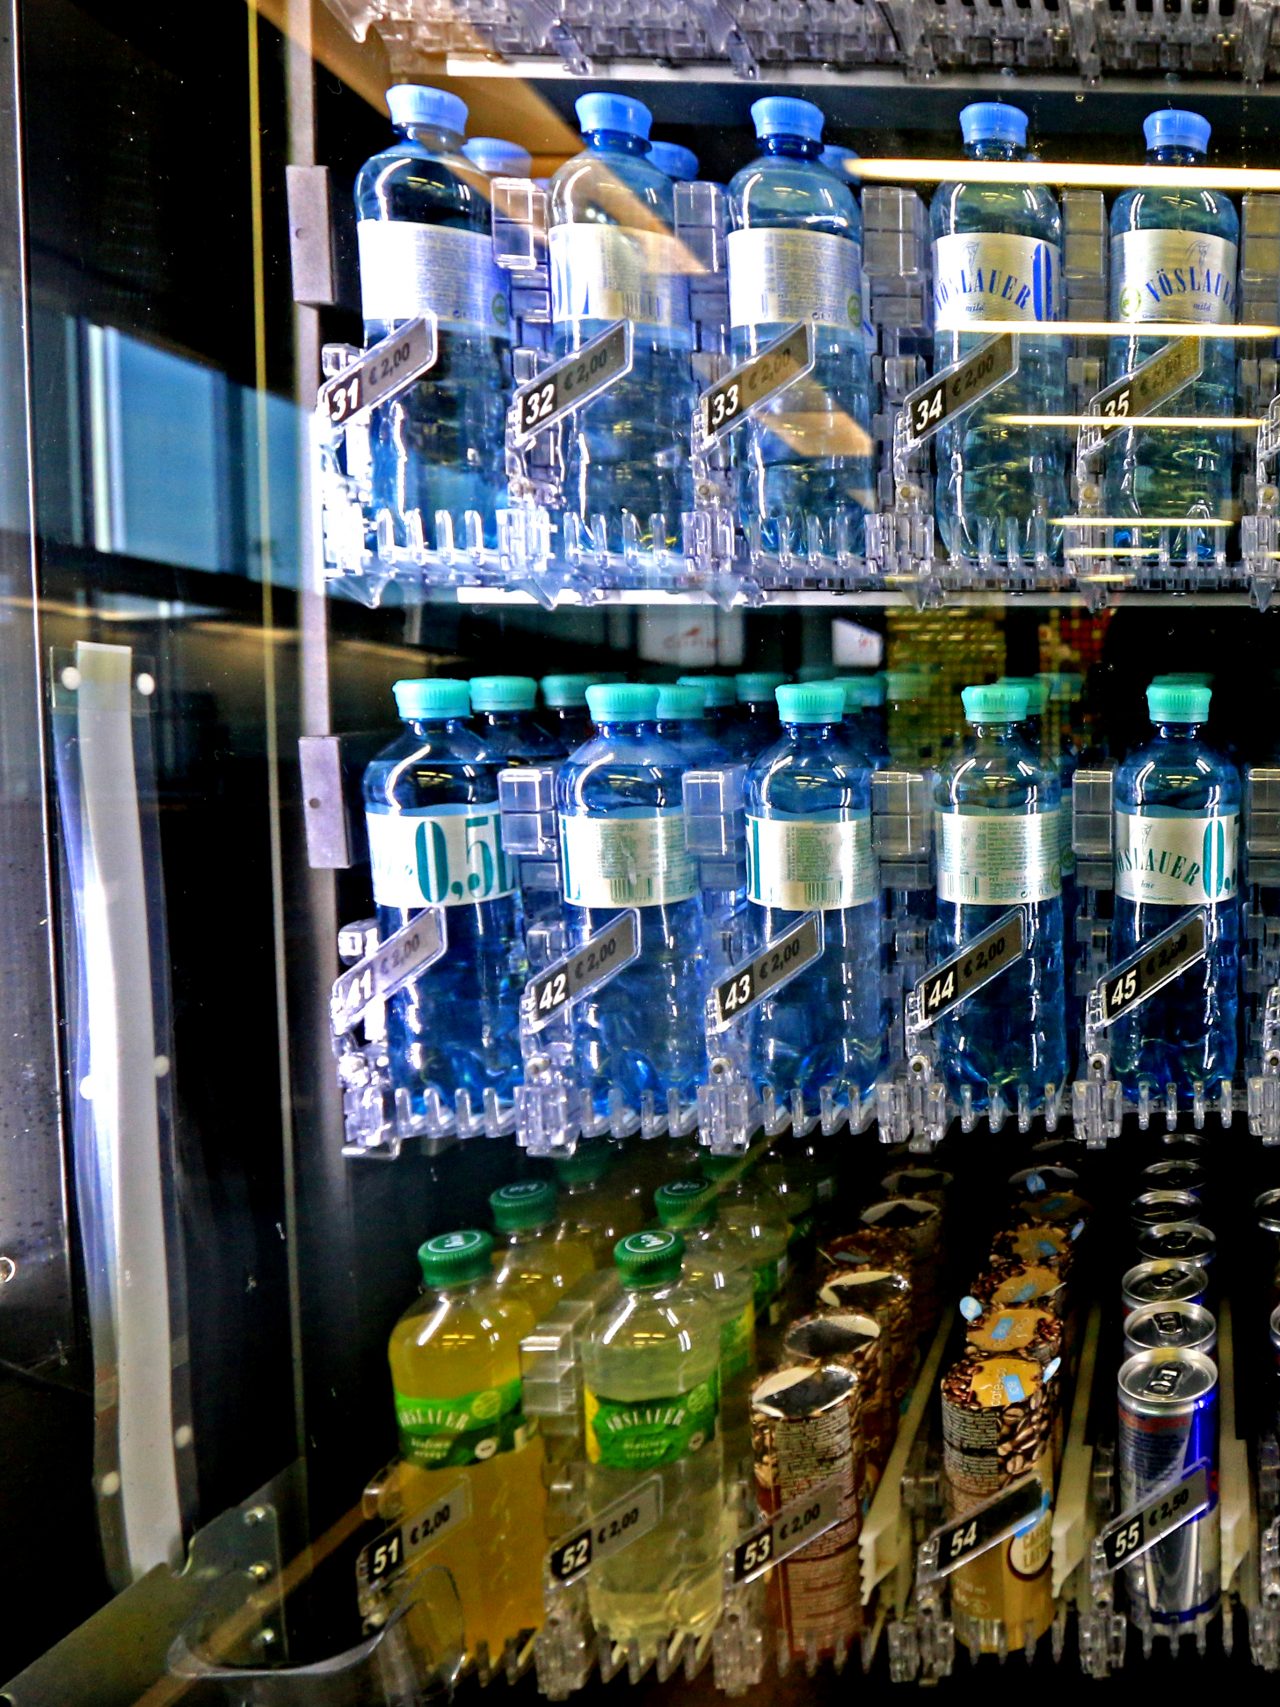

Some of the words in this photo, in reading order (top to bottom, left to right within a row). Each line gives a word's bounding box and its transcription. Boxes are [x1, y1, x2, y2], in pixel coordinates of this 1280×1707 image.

[331, 379, 359, 420] 31
[368, 366, 379, 385] €
[380, 342, 411, 379] 2,00
[525, 383, 555, 425] 32
[563, 373, 574, 391] €
[576, 347, 608, 383] 2,00
[712, 385, 739, 424] 33
[749, 372, 759, 391] €
[916, 389, 943, 431] 34
[952, 378, 963, 397] €
[965, 353, 994, 389] 2,00
[1103, 391, 1130, 431] 35
[348, 976, 371, 1006] 41
[379, 962, 389, 976] €
[390, 934, 420, 973] 2,00
[540, 973, 567, 1012] 42
[575, 962, 585, 979] €
[587, 938, 616, 972] 2,00
[725, 974, 750, 1010] 43
[759, 964, 769, 980] €
[770, 938, 800, 973] 2,00
[927, 976, 954, 1008] 44
[963, 959, 973, 977] €
[975, 937, 1005, 968] 2,00
[1111, 970, 1137, 1006] 45
[373, 1541, 399, 1575] 51
[409, 1531, 419, 1544] €
[422, 1505, 450, 1541] 2,00
[562, 1543, 588, 1581] 52
[598, 1532, 606, 1544] €
[609, 1508, 639, 1537] 2,00
[743, 1537, 770, 1575] 53
[779, 1523, 788, 1539] €
[791, 1504, 821, 1535] 2,00
[950, 1521, 977, 1556] 54
[1114, 1521, 1140, 1558] 55
[1148, 1510, 1158, 1528] €
[1160, 1488, 1189, 1519] 2,50
